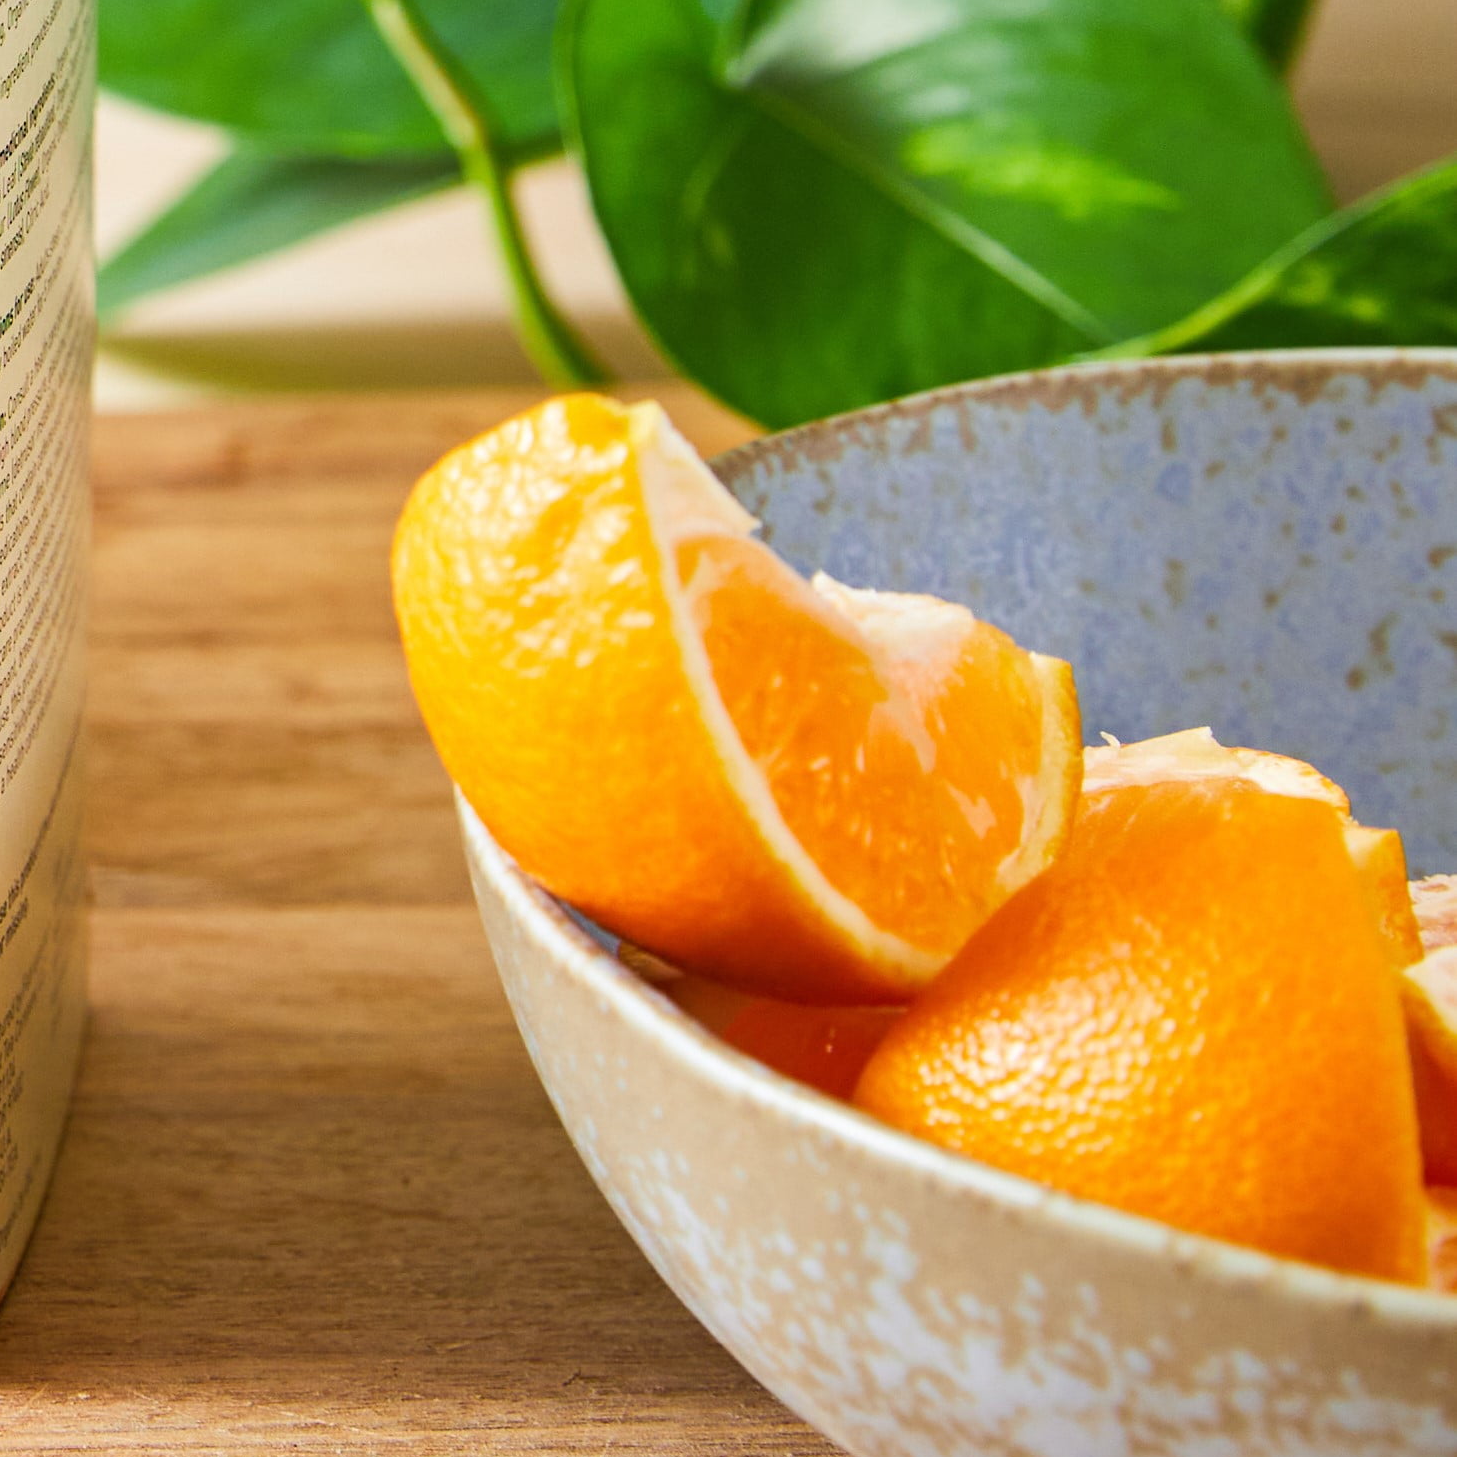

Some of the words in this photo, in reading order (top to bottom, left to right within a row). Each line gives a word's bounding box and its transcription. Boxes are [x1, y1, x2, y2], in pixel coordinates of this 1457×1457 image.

[3, 161, 16, 199] Leaf
[14, 292, 23, 319] for
[3, 327, 21, 369] boiled
[5, 492, 17, 524] that
